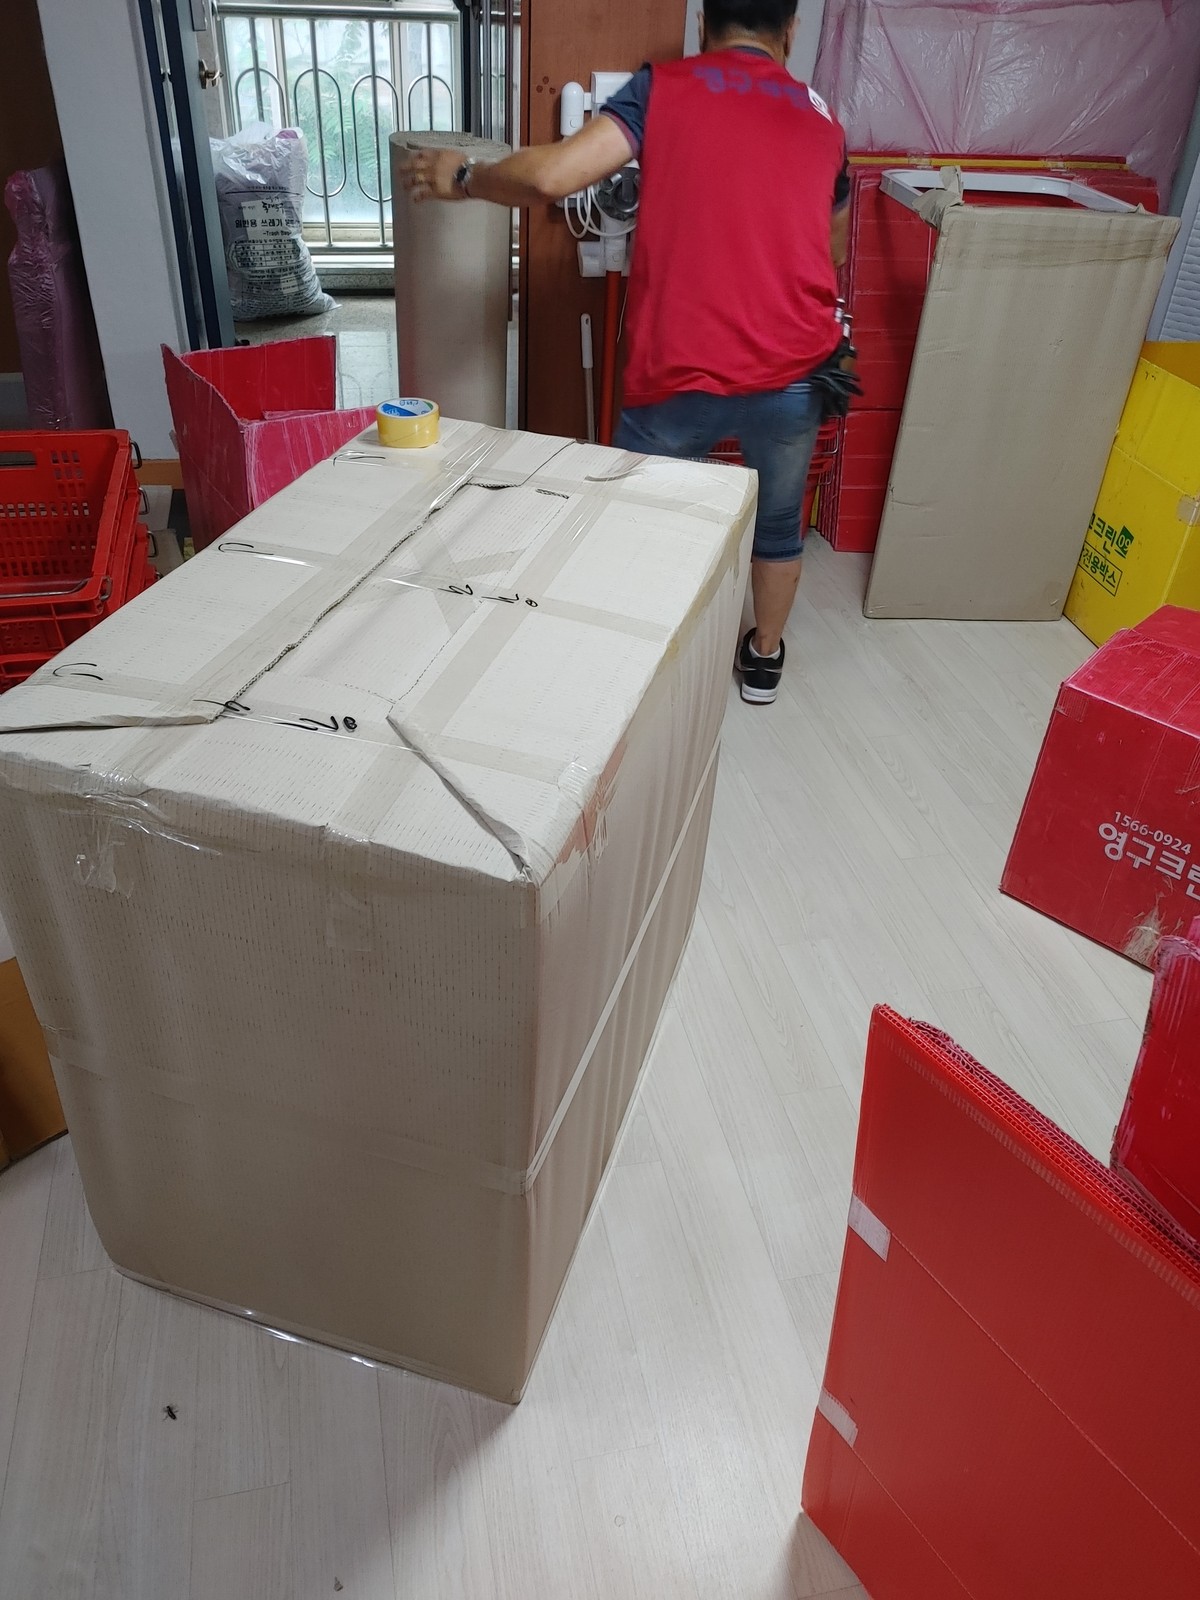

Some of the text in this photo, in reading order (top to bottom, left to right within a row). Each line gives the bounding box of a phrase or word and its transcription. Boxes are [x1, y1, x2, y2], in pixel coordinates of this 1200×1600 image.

[235, 219, 257, 228] 일반용
[261, 219, 282, 228] 쓰레기
[1114, 811, 1192, 856] 1566-0924
